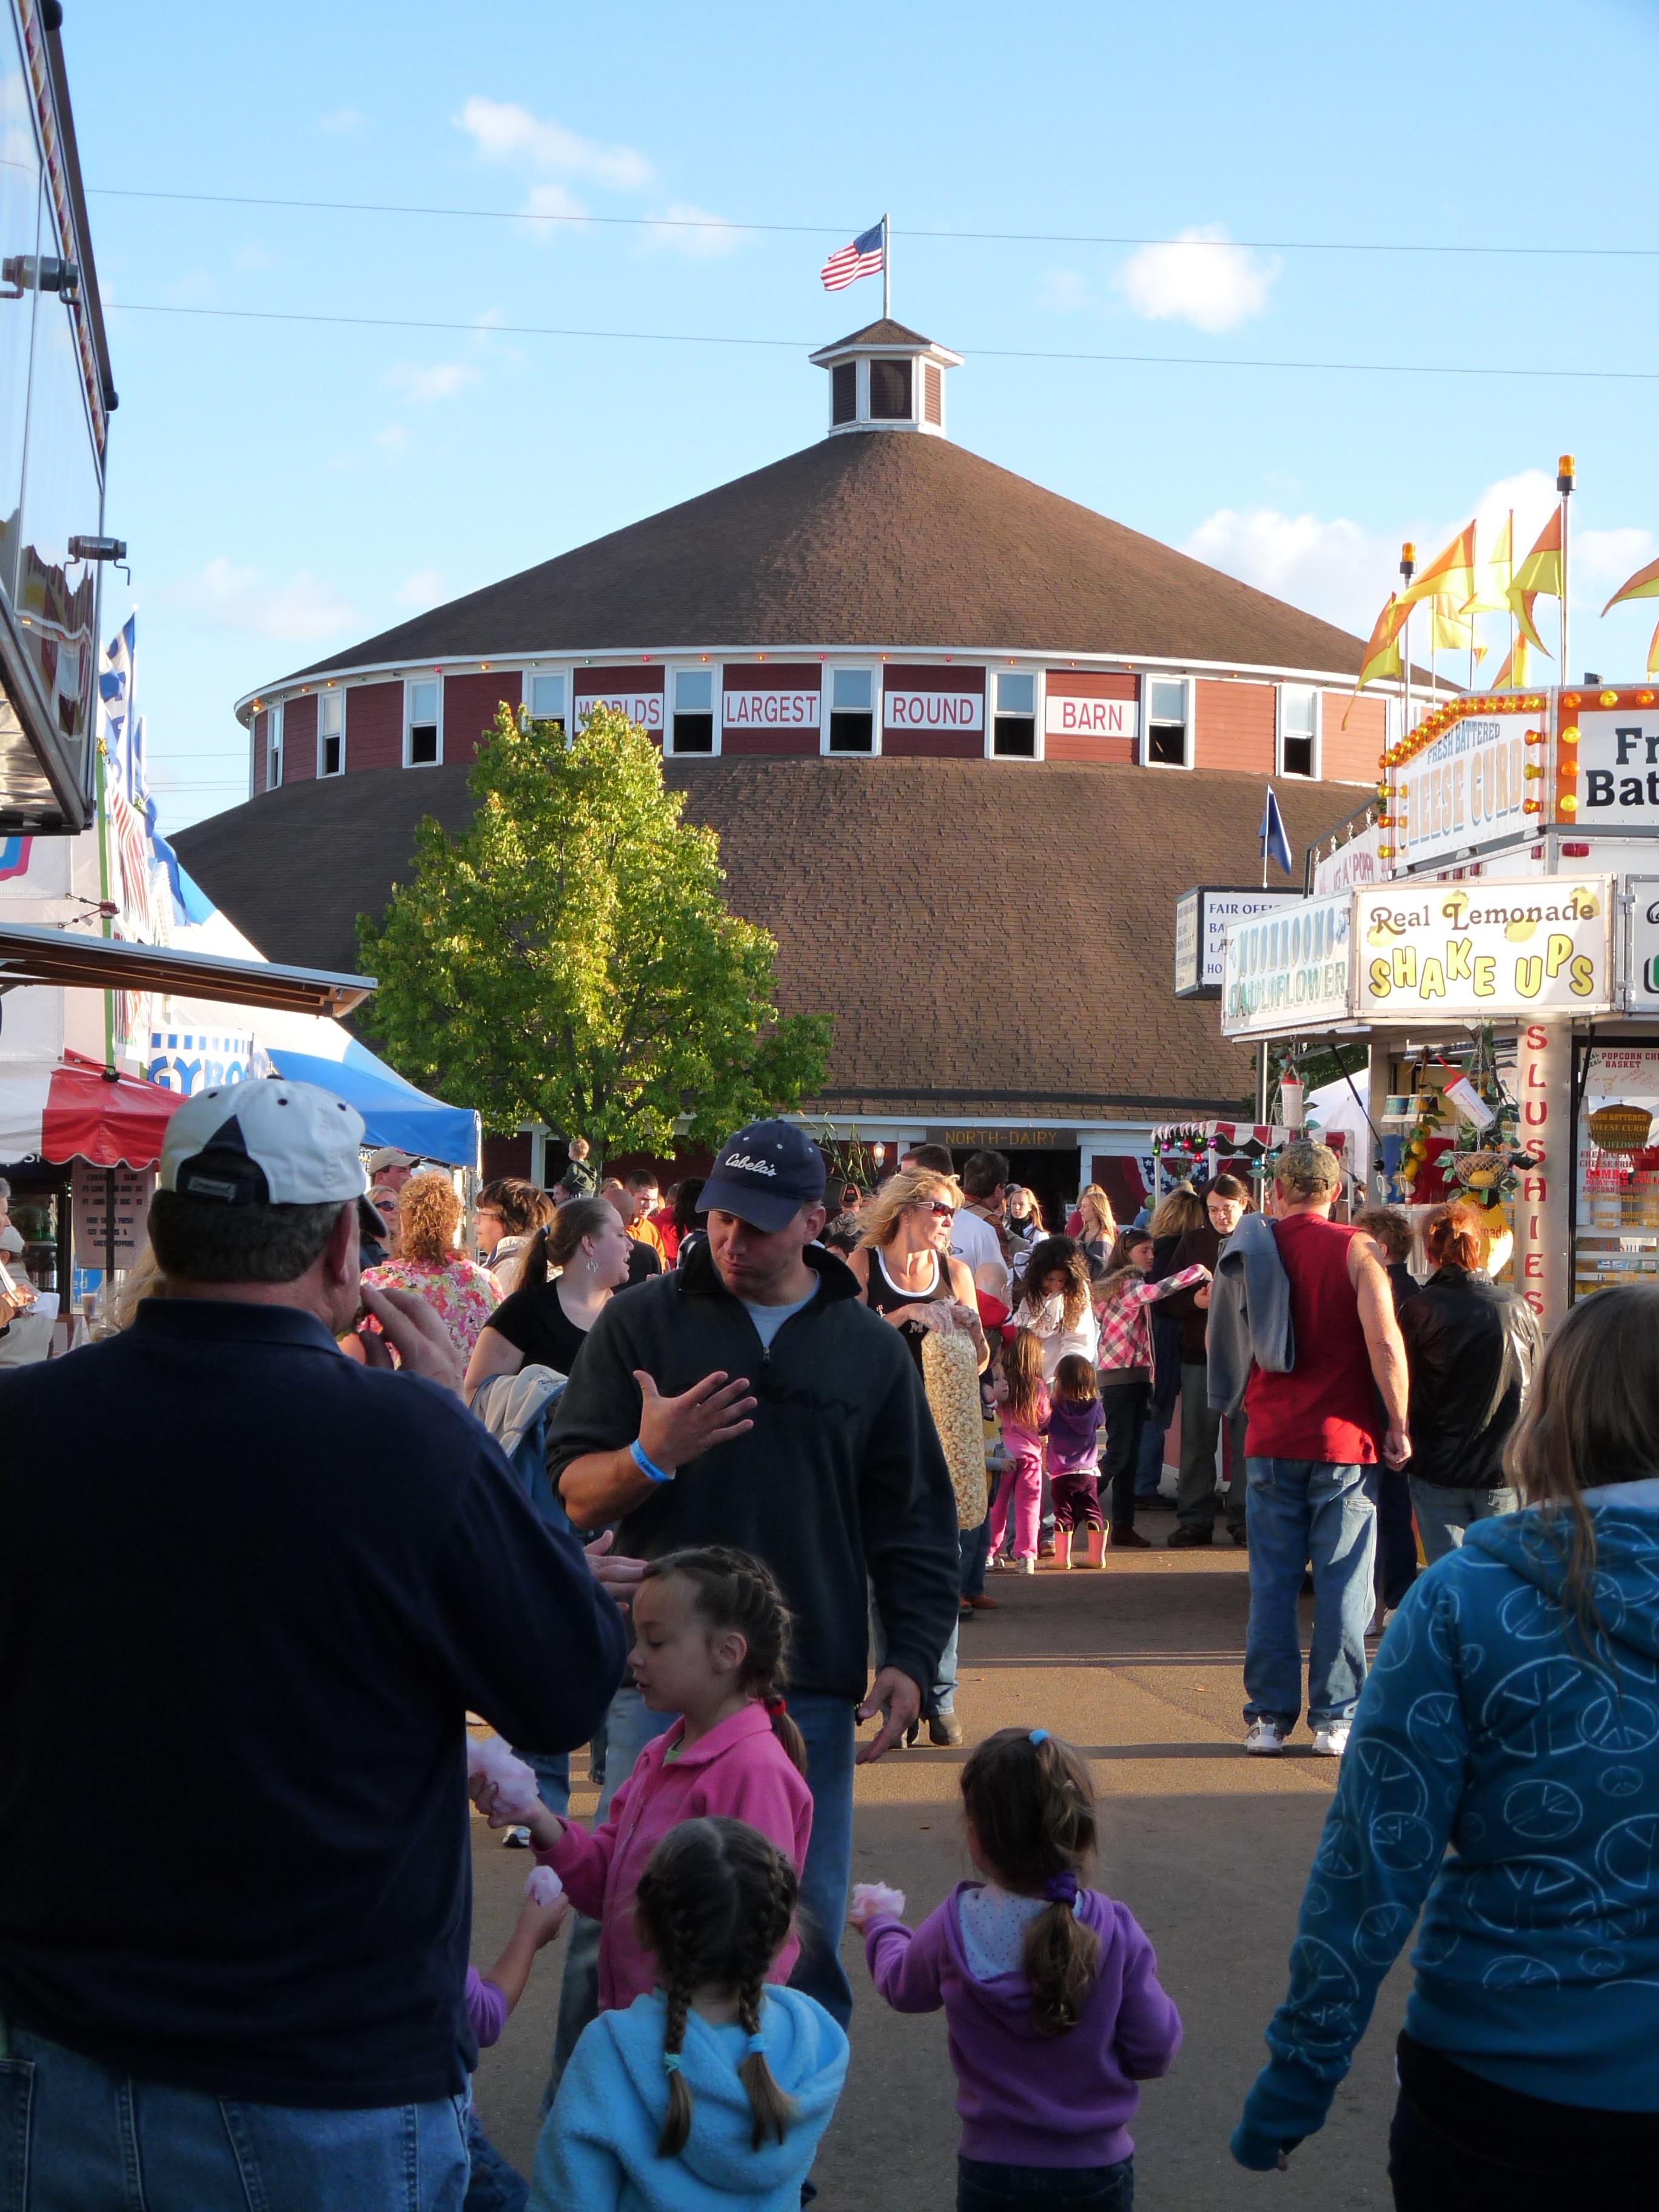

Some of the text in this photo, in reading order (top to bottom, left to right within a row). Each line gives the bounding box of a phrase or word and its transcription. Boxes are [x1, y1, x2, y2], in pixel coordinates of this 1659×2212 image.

[726, 695, 817, 722] LARGEST
[893, 697, 974, 725] ROUND
[1063, 702, 1122, 731] BARN
[1427, 720, 1500, 765] FRESH BATTERED
[1398, 738, 1537, 849] CHEESE CURDS
[1586, 769, 1659, 807] Bat
[1210, 903, 1280, 914] FAIR OFF
[1370, 897, 1594, 935] Real Lemonade
[1369, 937, 1496, 999] SHAKE
[1515, 934, 1594, 998] UPS
[1228, 961, 1346, 1018] CAULIFLOWER
[945, 1130, 1058, 1145] NORTH-DAIRY
[725, 1153, 777, 1176] Cabela's
[1524, 1024, 1547, 1316] SLUSHIES
[1586, 1168, 1628, 1178] COMBO
